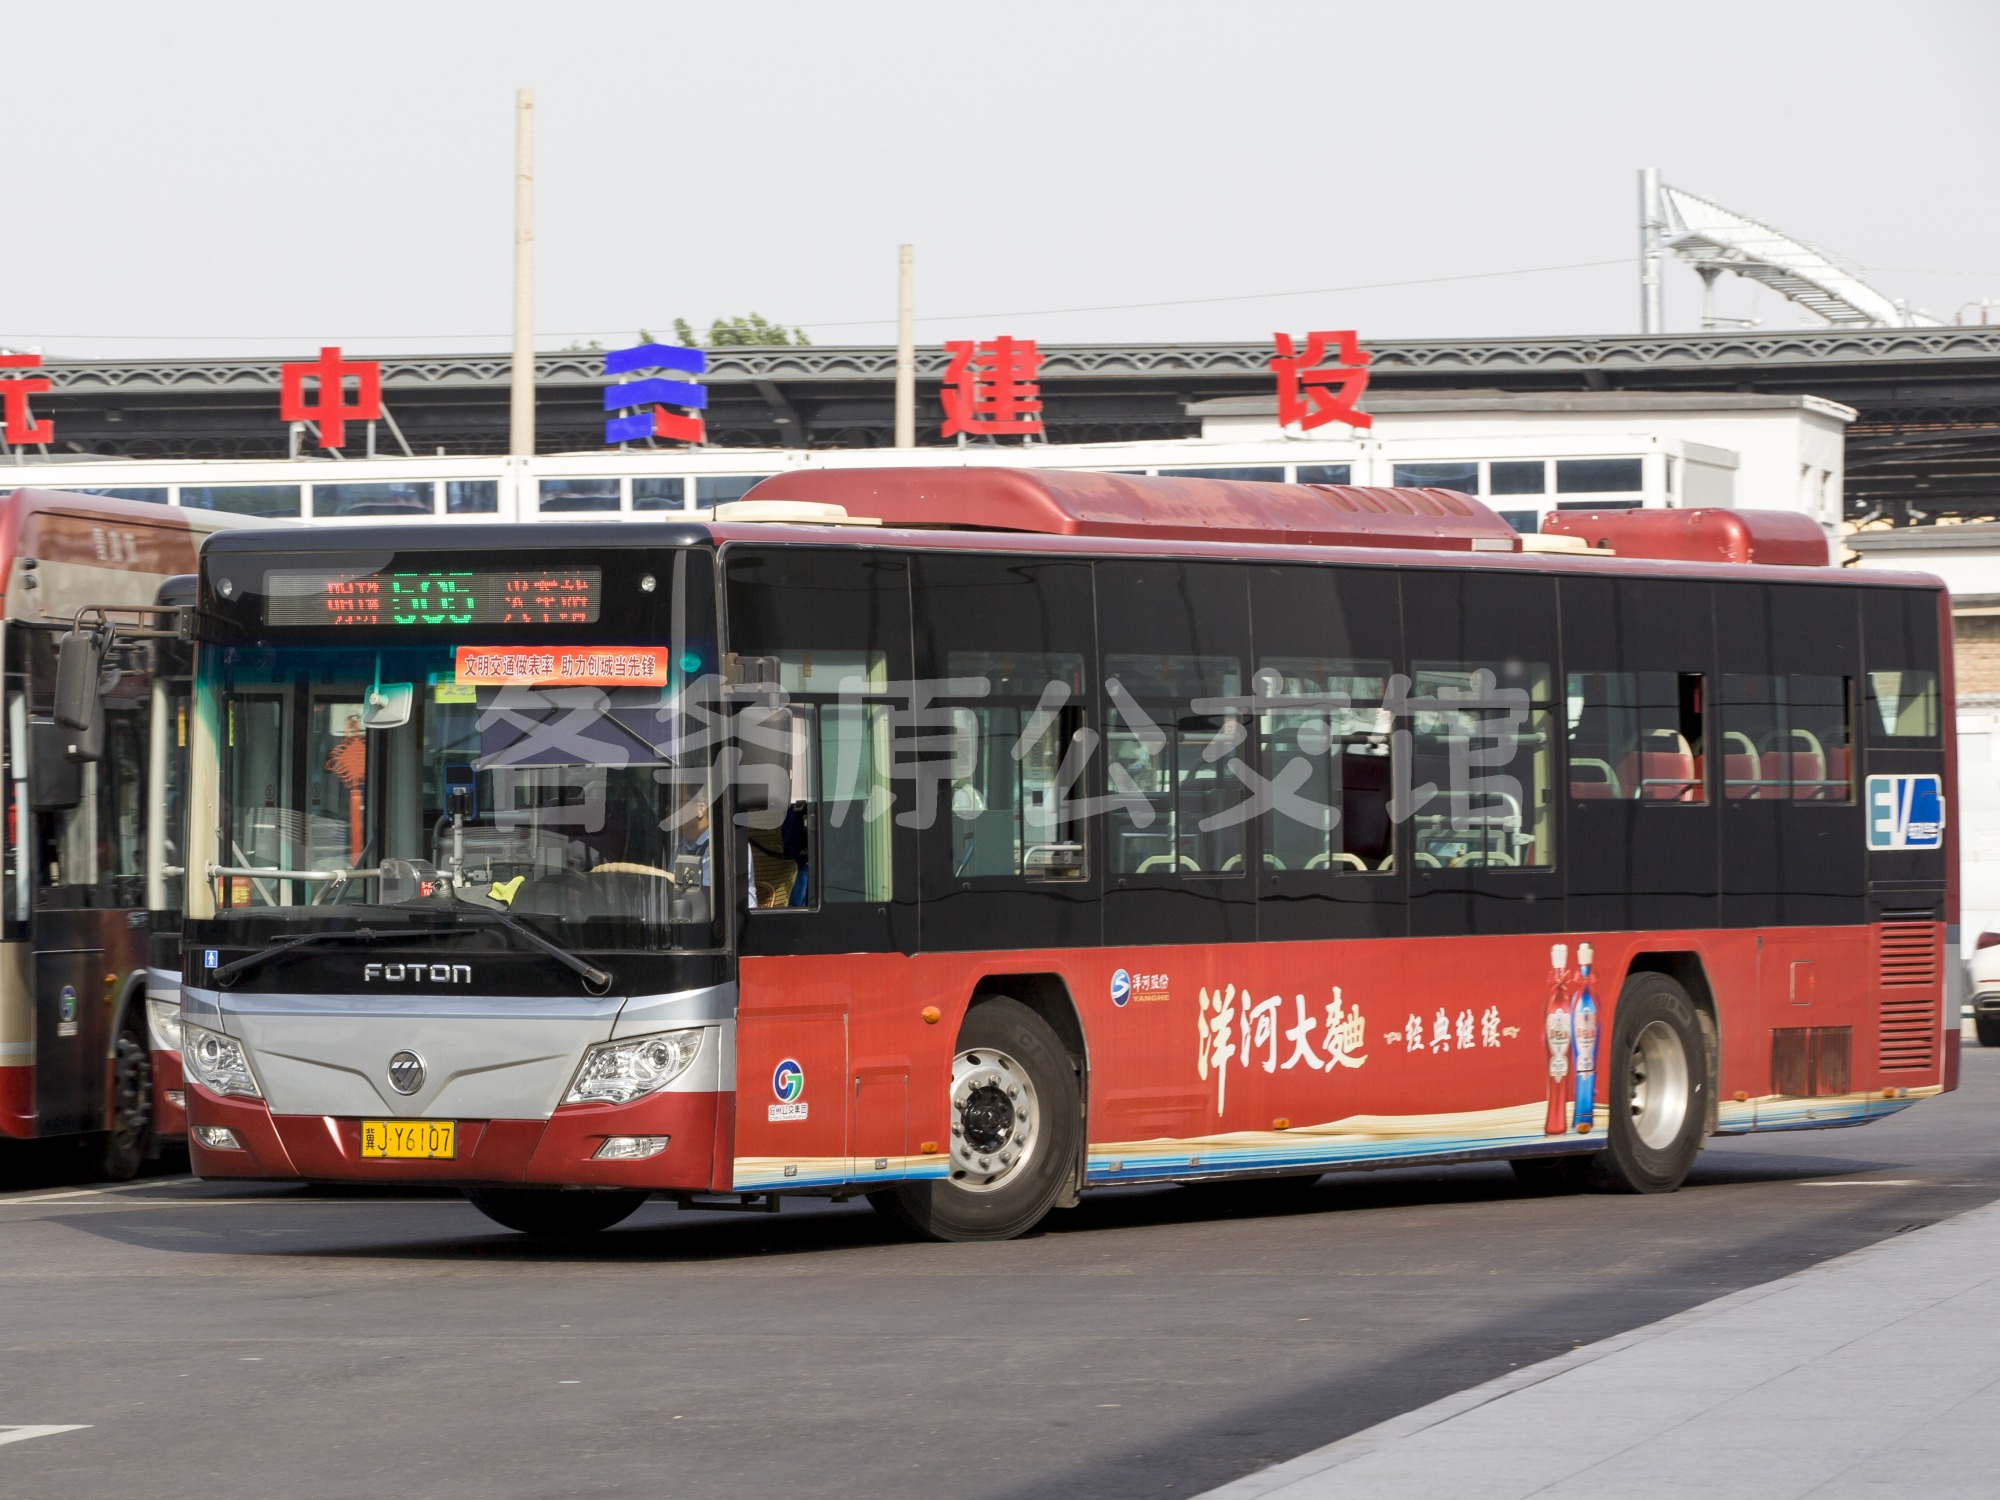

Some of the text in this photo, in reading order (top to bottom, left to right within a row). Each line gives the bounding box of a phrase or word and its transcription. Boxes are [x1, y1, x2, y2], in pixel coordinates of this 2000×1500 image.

[464, 654, 656, 677] 文明交通做表率 助力创城当先锋
[364, 963, 471, 984] FOTON
[1132, 994, 1170, 1002] YANGHE
